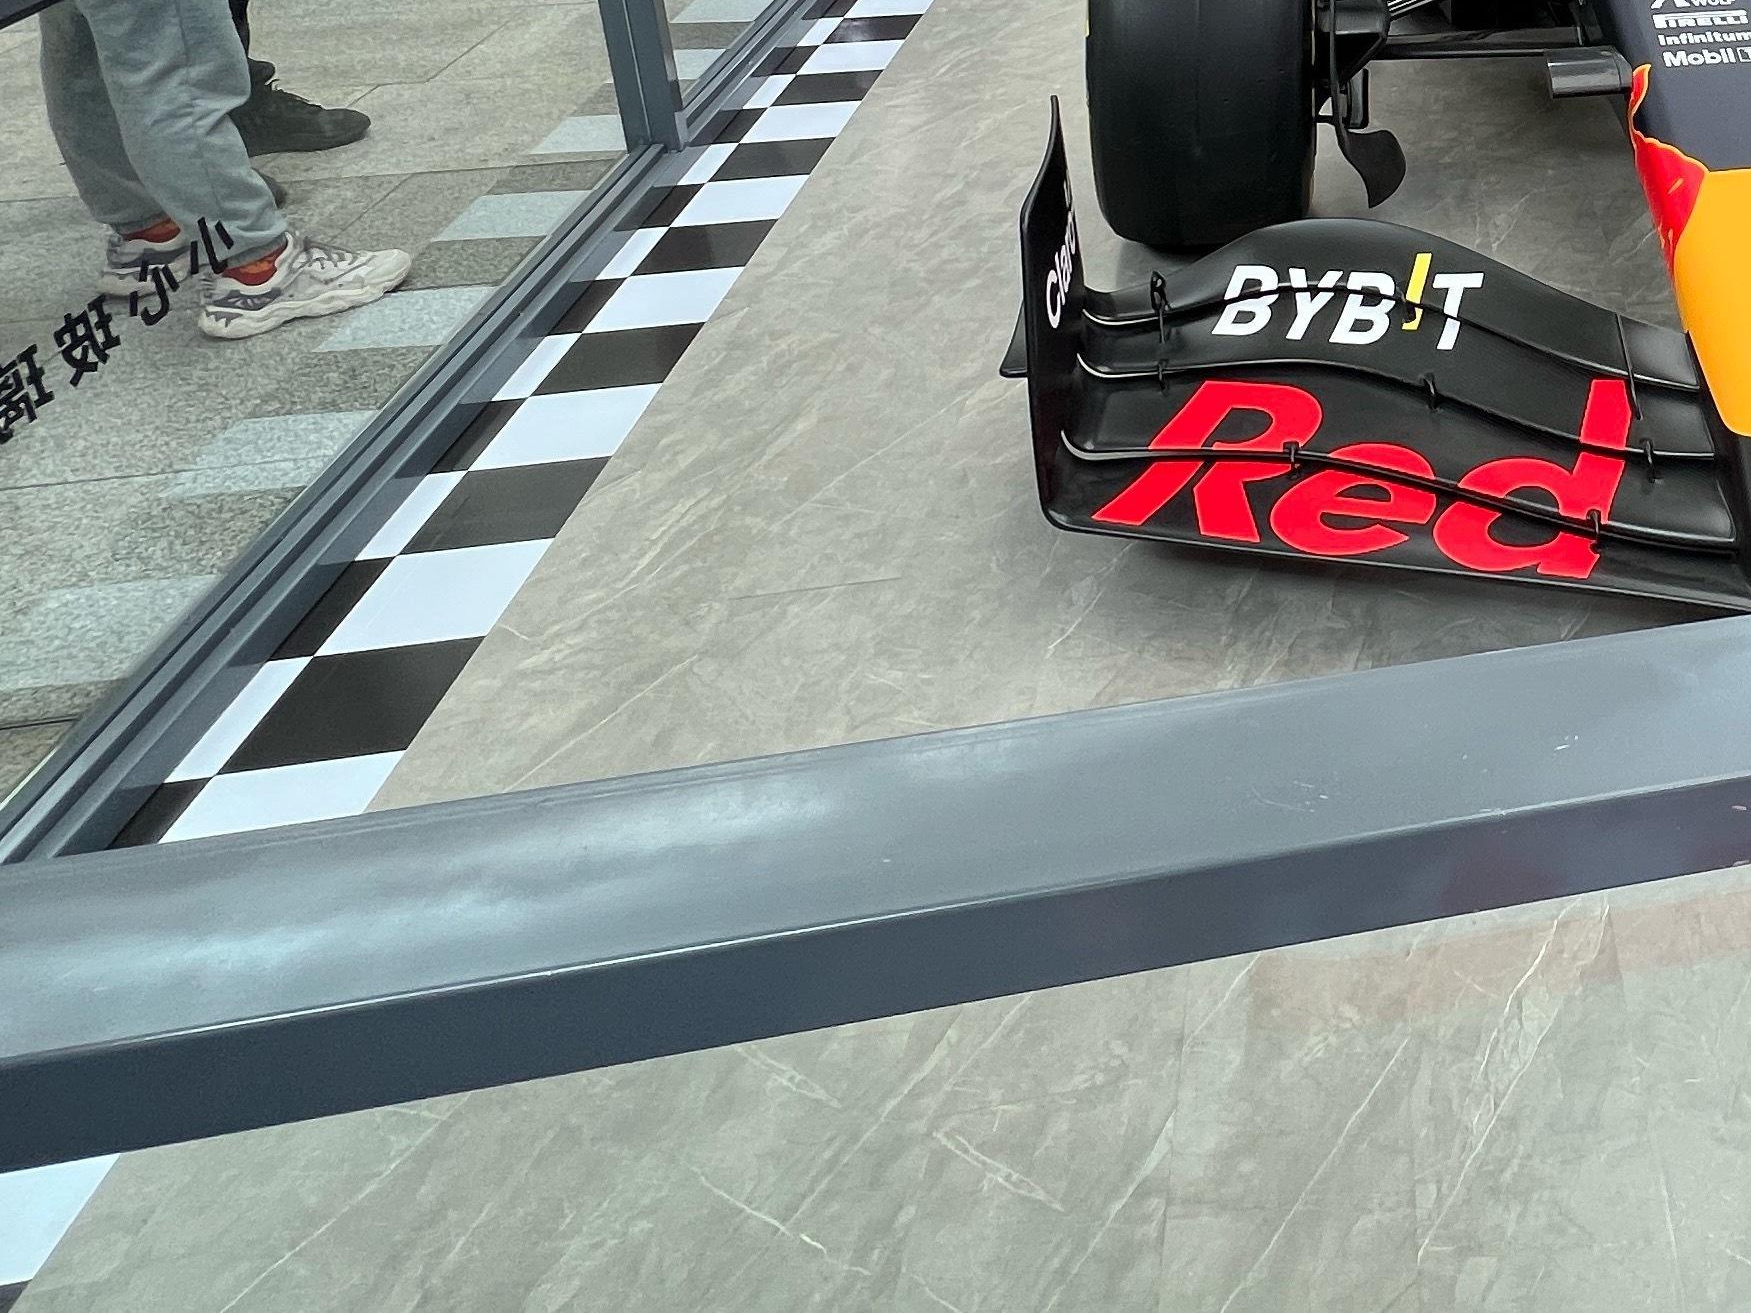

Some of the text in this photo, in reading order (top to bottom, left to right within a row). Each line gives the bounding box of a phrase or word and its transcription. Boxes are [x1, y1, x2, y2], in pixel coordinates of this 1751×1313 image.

[1652, 9, 1749, 29] PIRELLI
[1662, 48, 1737, 68] Mobil
[1211, 252, 1485, 350] BYBIT
[1091, 378, 1633, 579] Red
